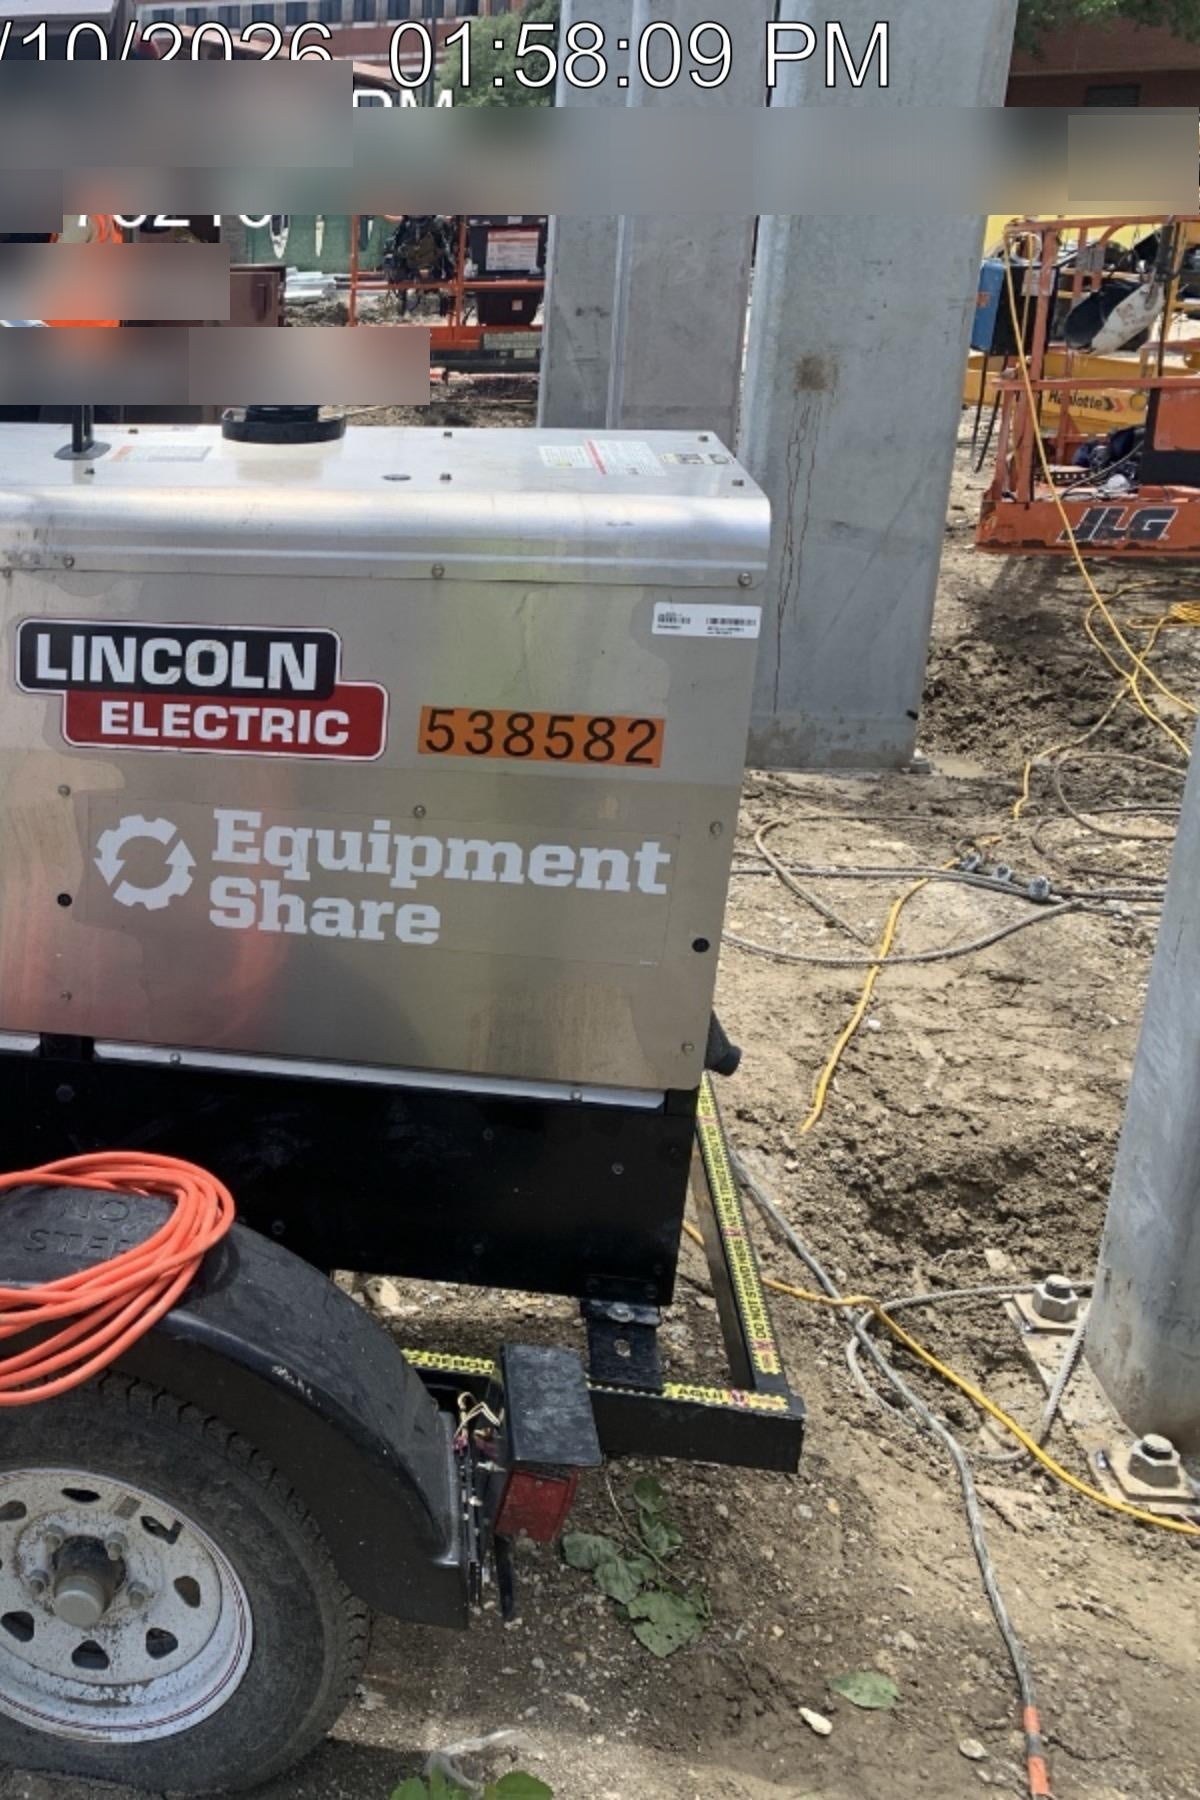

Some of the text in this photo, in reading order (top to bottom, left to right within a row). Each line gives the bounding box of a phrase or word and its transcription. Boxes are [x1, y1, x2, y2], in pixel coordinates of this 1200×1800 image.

[1056, 506, 1178, 543] JLG
[36, 632, 318, 691] LINCOLN
[101, 700, 350, 746] ELECTRIC
[425, 708, 657, 765] 538582
[211, 808, 672, 895] Equipment
[209, 876, 441, 945] Share
